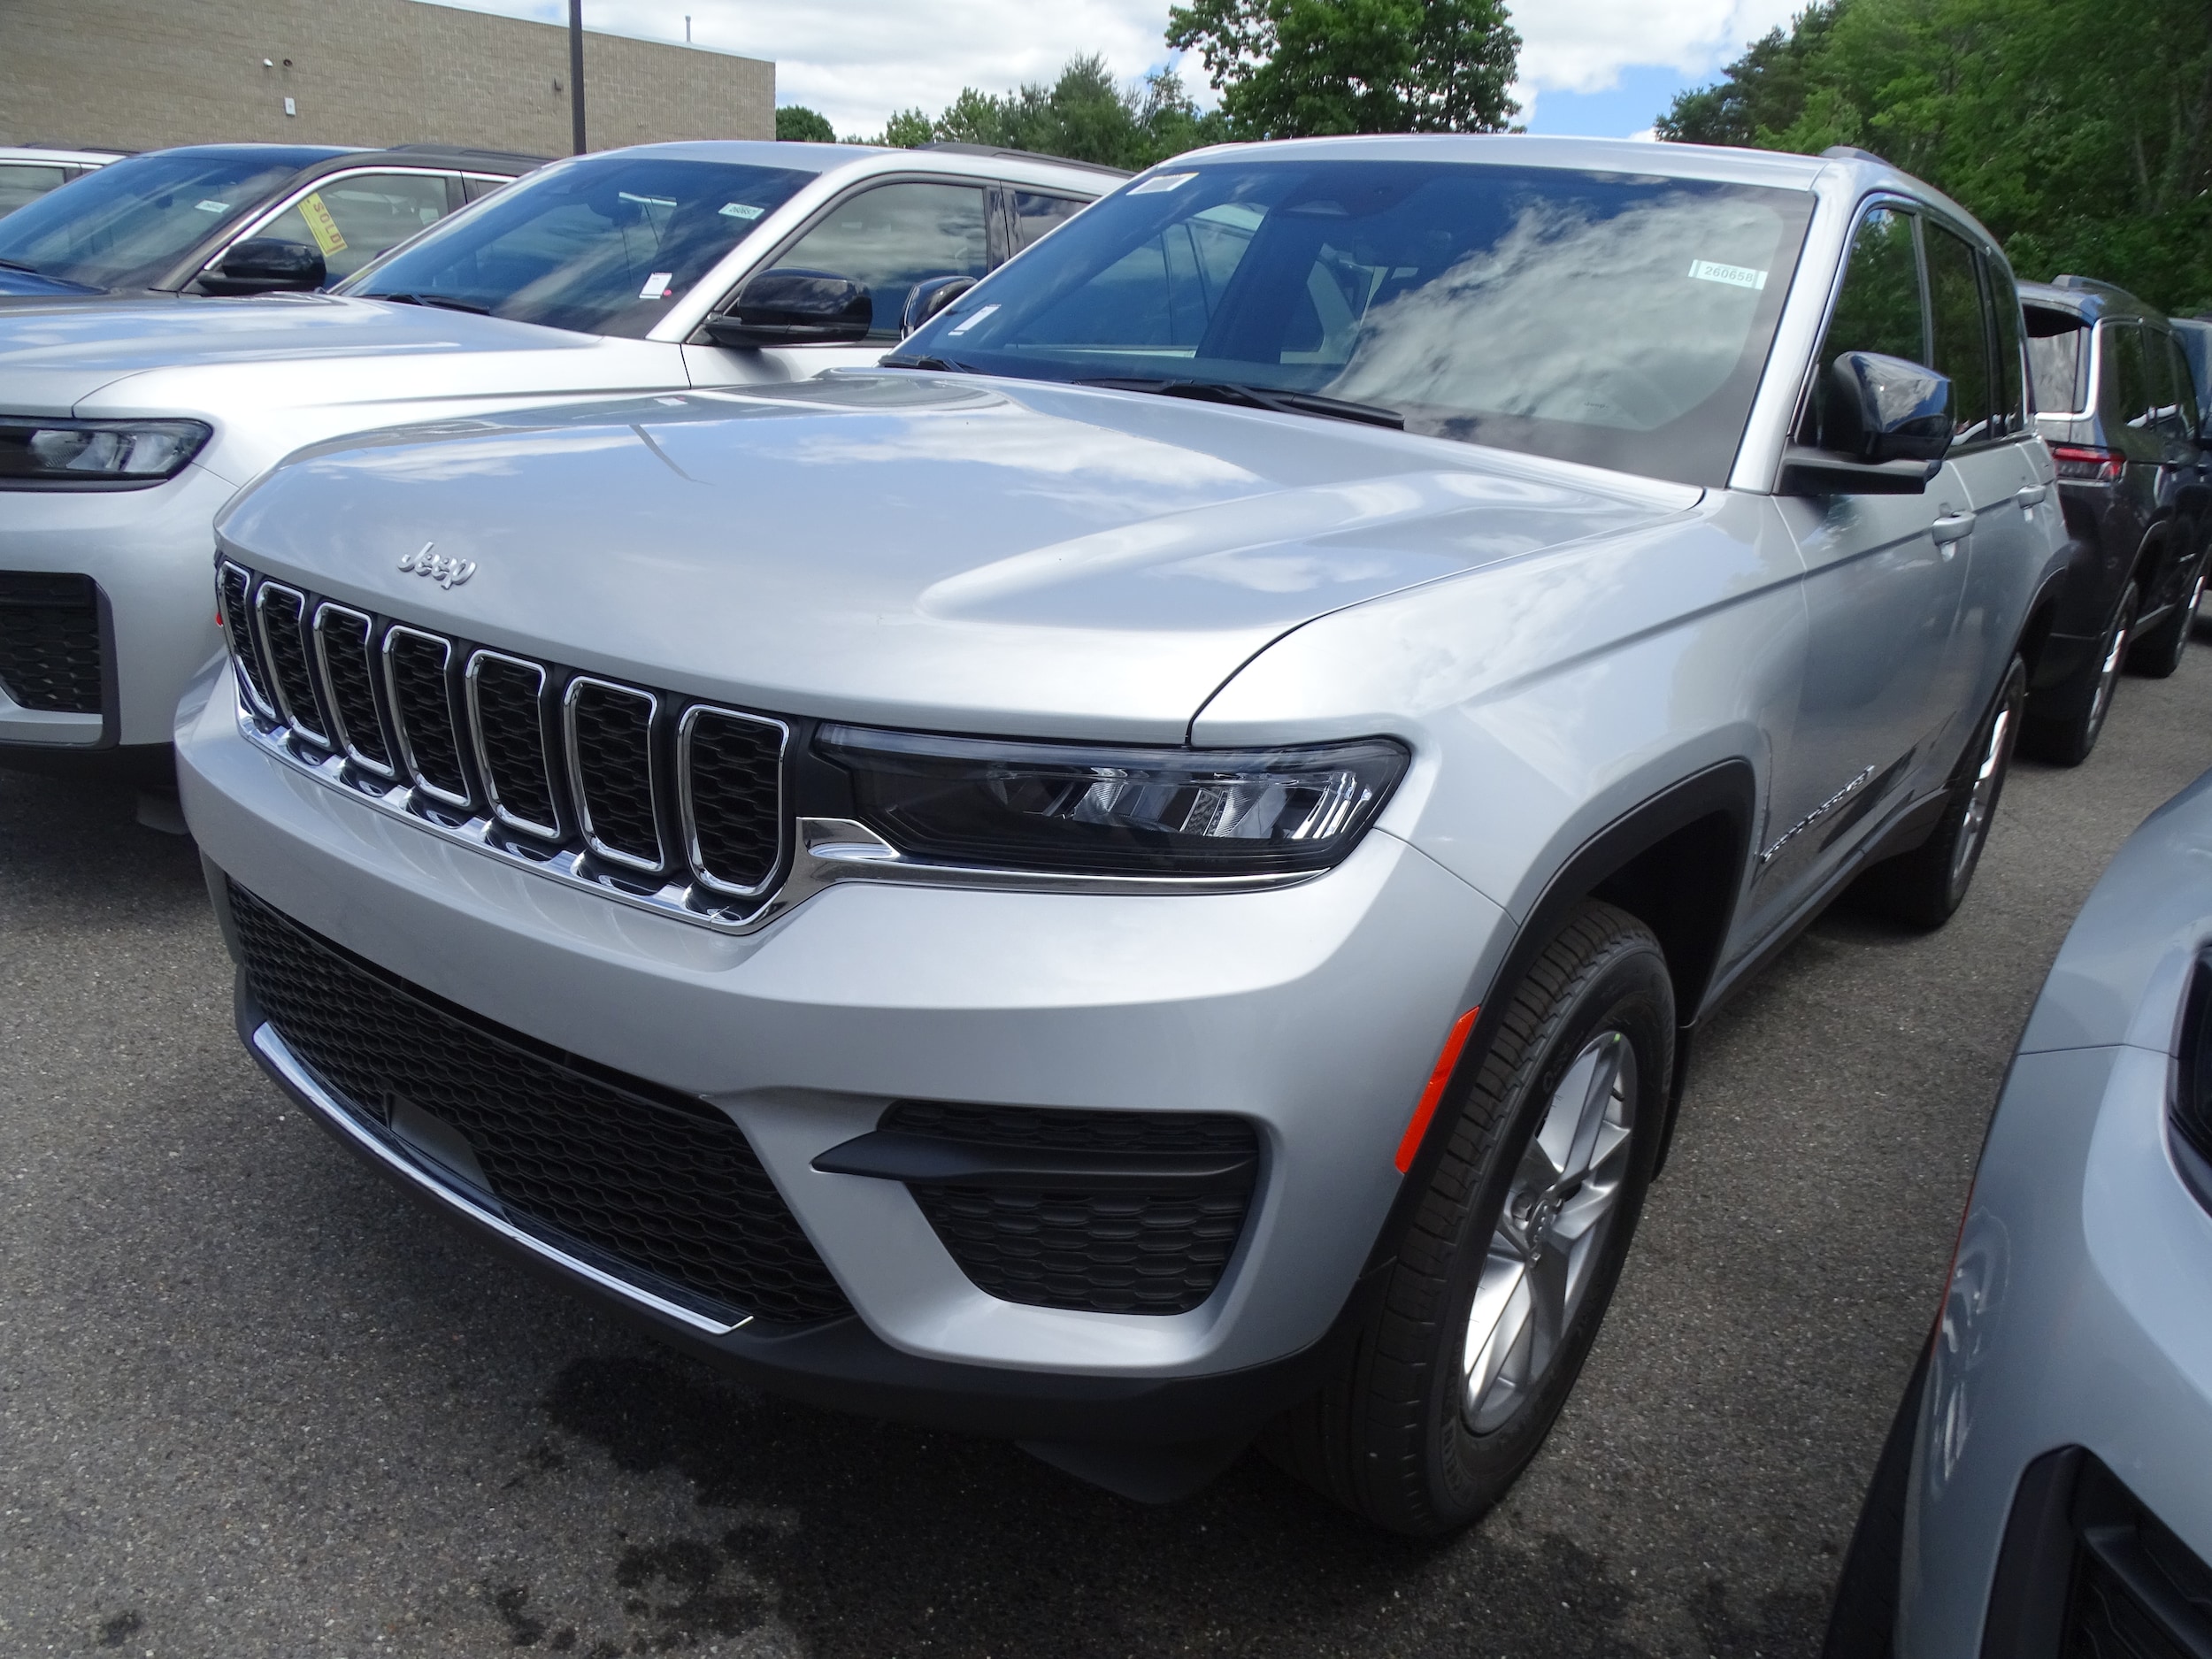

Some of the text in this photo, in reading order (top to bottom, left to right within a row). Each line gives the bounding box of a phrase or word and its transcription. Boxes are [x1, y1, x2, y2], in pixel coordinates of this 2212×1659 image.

[313, 202, 342, 243] SOLD
[1703, 265, 1754, 282] 260658
[396, 541, 477, 590] Jeep
